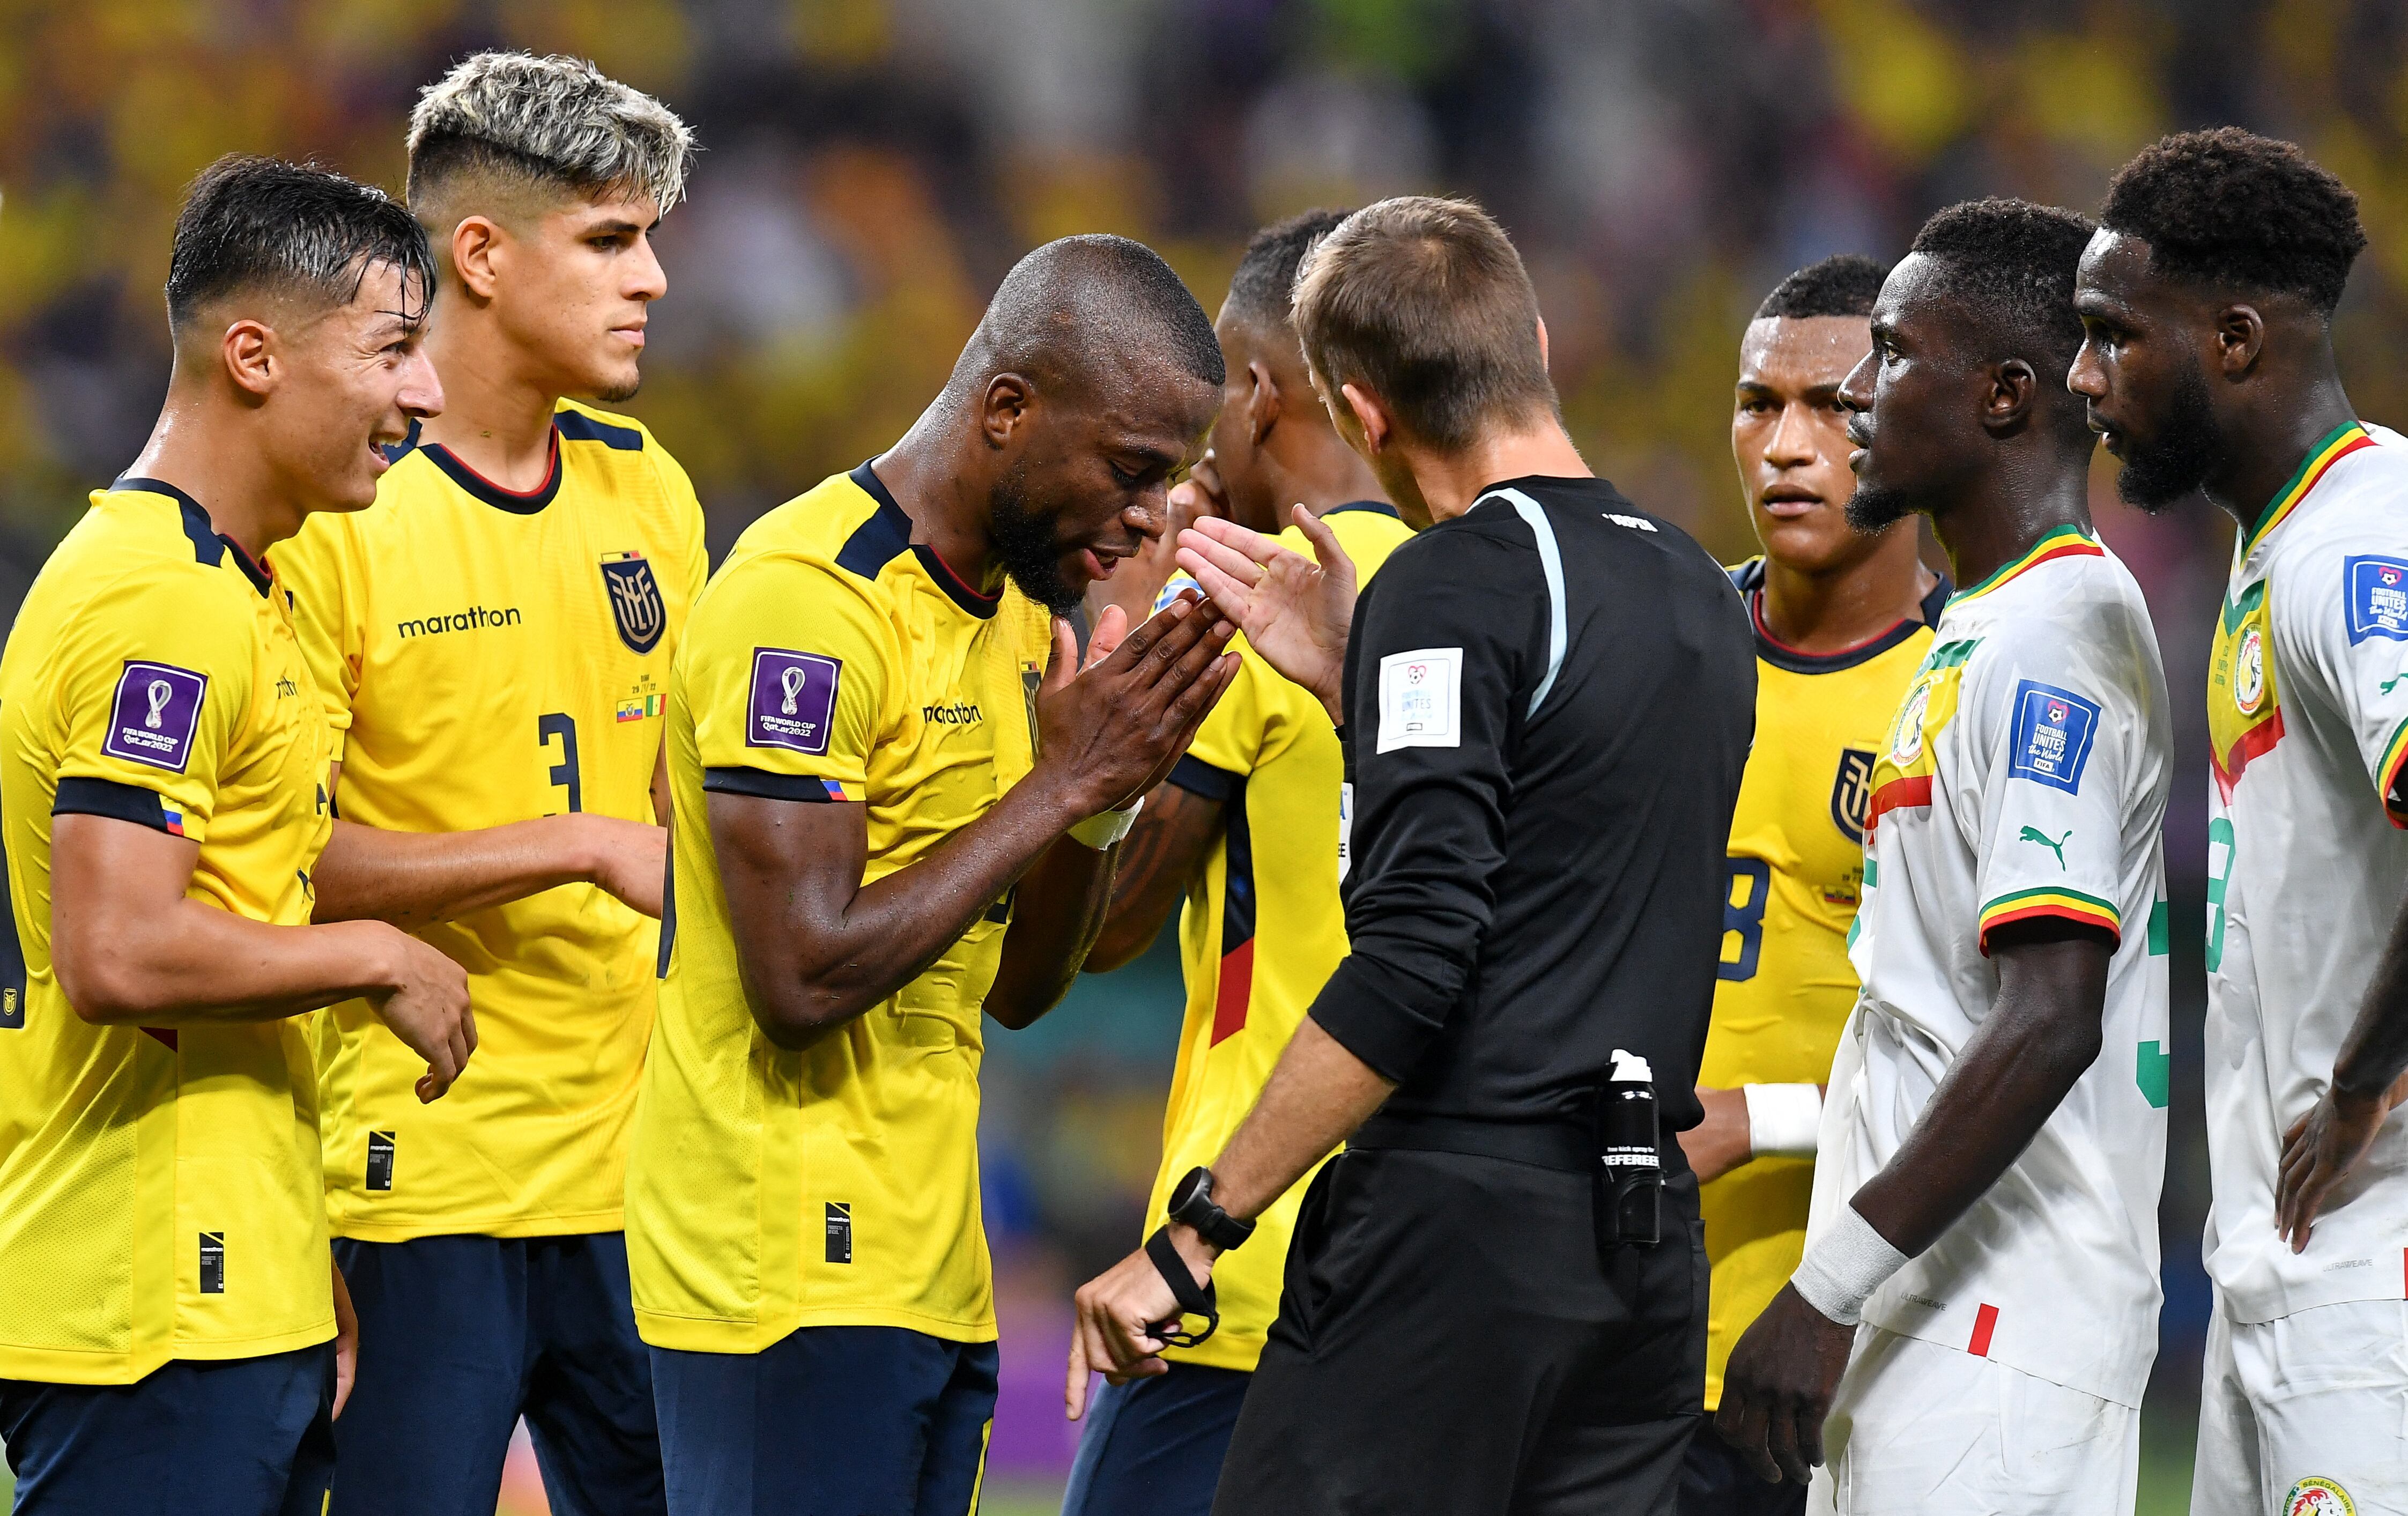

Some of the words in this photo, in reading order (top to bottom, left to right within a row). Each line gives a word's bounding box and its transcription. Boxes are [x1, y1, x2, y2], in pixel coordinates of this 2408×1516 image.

[2372, 595, 2406, 610] UNITES
[398, 605, 521, 638] marathon
[775, 718, 801, 727] WORLD
[138, 730, 164, 741] WORLD
[2035, 723, 2067, 741] FOOTBALL
[2033, 732, 2065, 752] UNITES
[2028, 744, 2041, 755] the
[2041, 748, 2065, 764] World
[538, 713, 582, 817] 3
[2323, 1259, 2373, 1271] ULTRAWEAVE
[1901, 1292, 1947, 1311] ULTRAWEAVE
